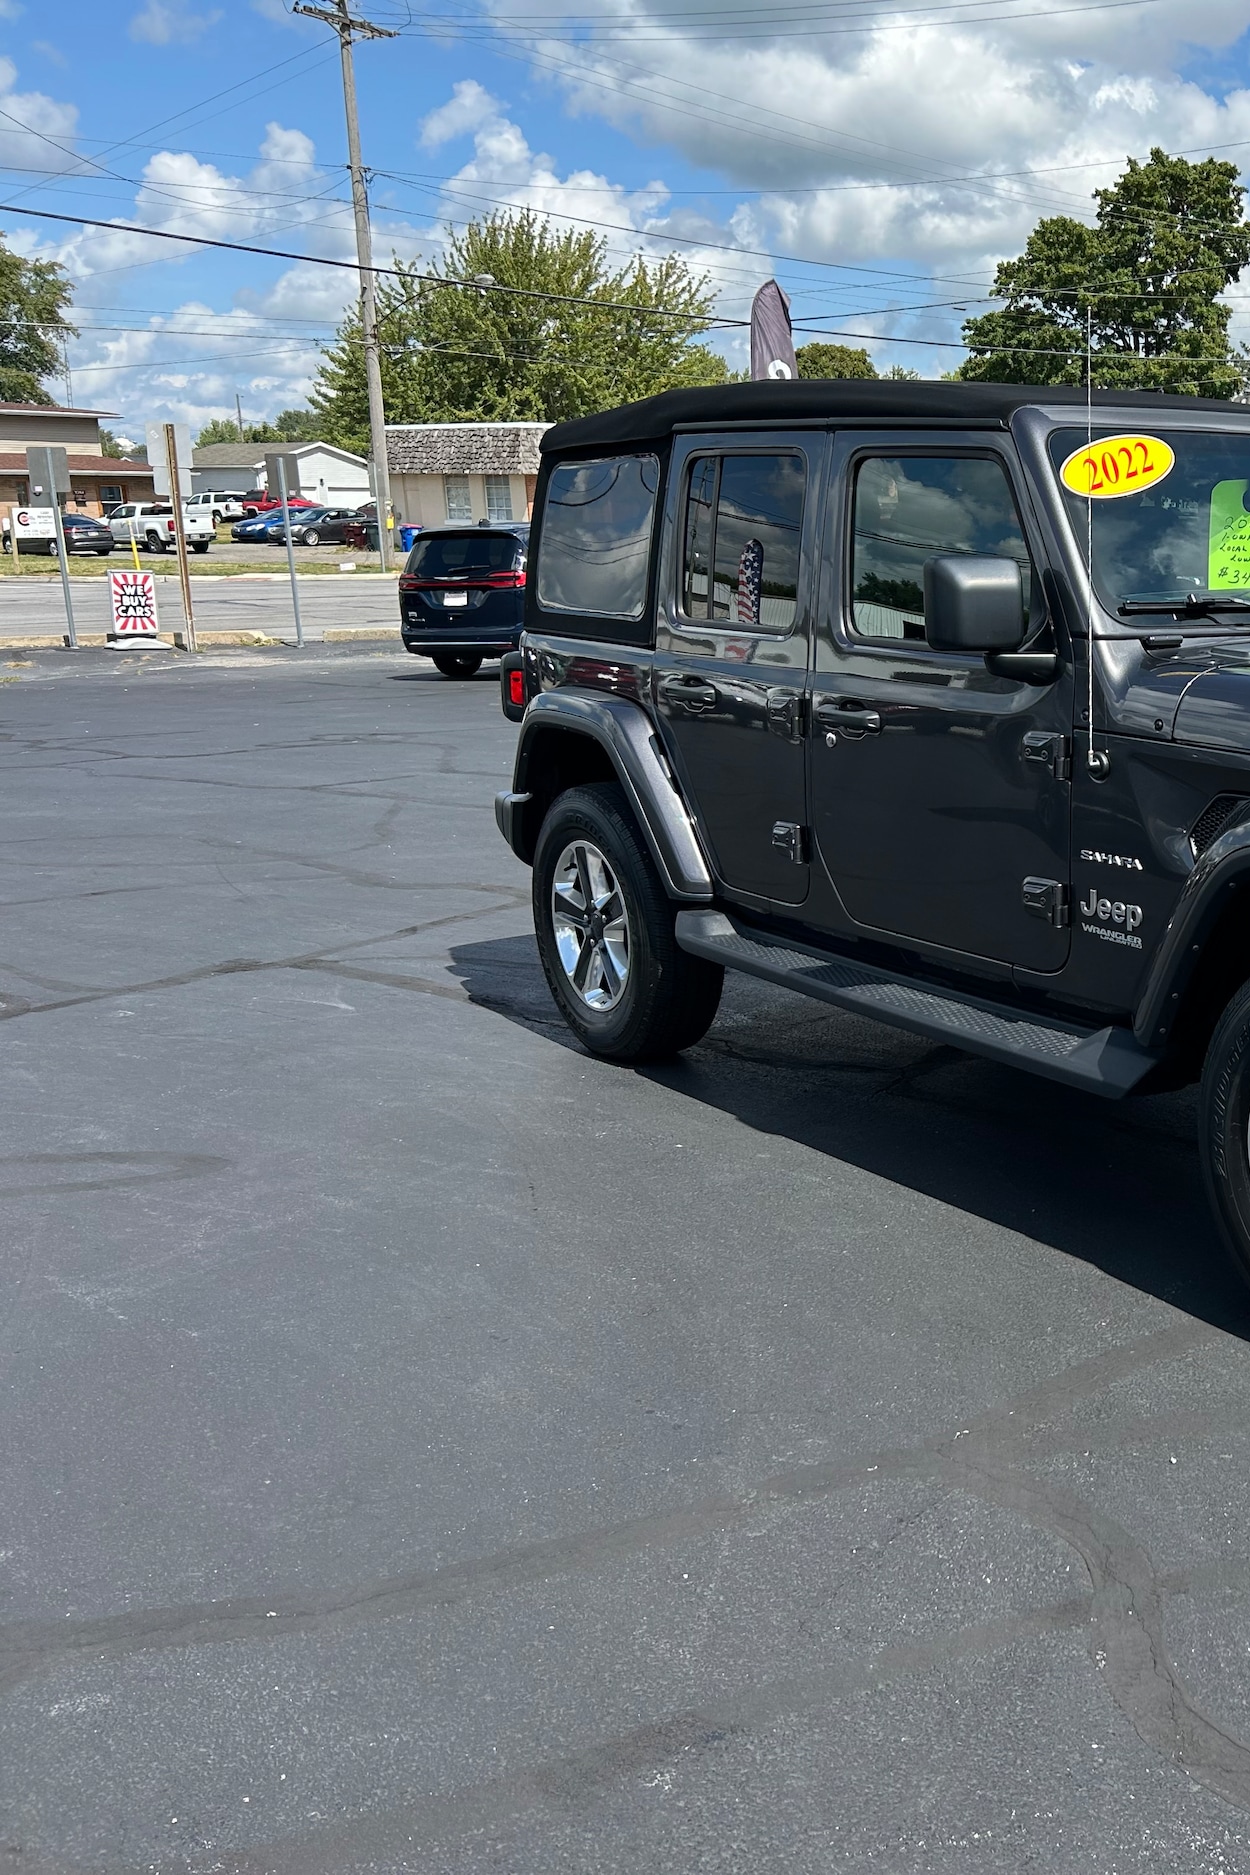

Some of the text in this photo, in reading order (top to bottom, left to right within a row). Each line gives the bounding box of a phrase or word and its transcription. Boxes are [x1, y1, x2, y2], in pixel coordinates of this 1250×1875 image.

[1083, 442, 1154, 491] 2022
[1220, 543, 1248, 552] LOCAL
[121, 584, 145, 596] WE
[121, 595, 148, 606] BUY
[117, 605, 152, 618] CARS
[1080, 849, 1143, 871] SAHARA
[1080, 889, 1143, 931] Jeep
[1081, 922, 1142, 945] WRANGLER
